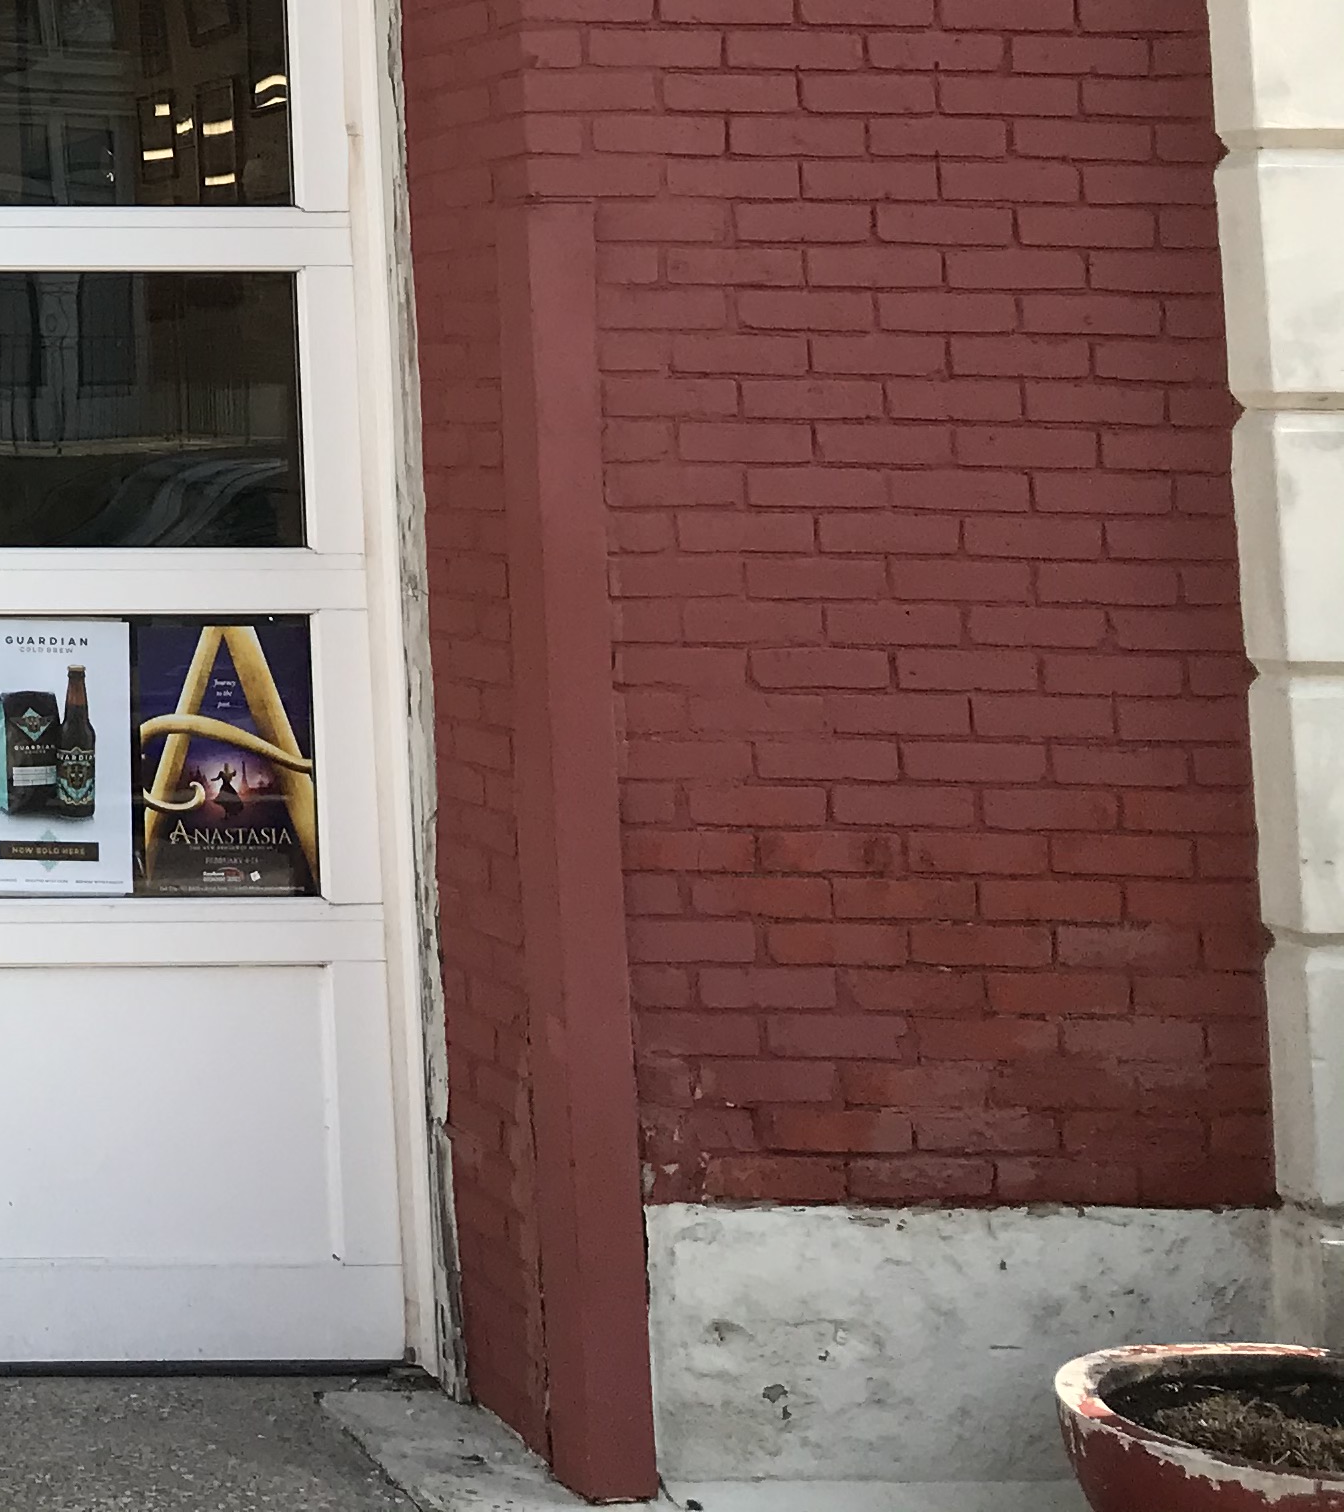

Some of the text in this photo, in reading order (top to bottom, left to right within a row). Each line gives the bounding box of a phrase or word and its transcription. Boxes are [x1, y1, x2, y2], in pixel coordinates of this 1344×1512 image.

[5, 635, 89, 646] GUARDIAN
[46, 646, 74, 654] BREW
[213, 679, 236, 688] Journey
[14, 743, 56, 751] GUARDIAN
[12, 846, 86, 855] NOW SOLD HERE
